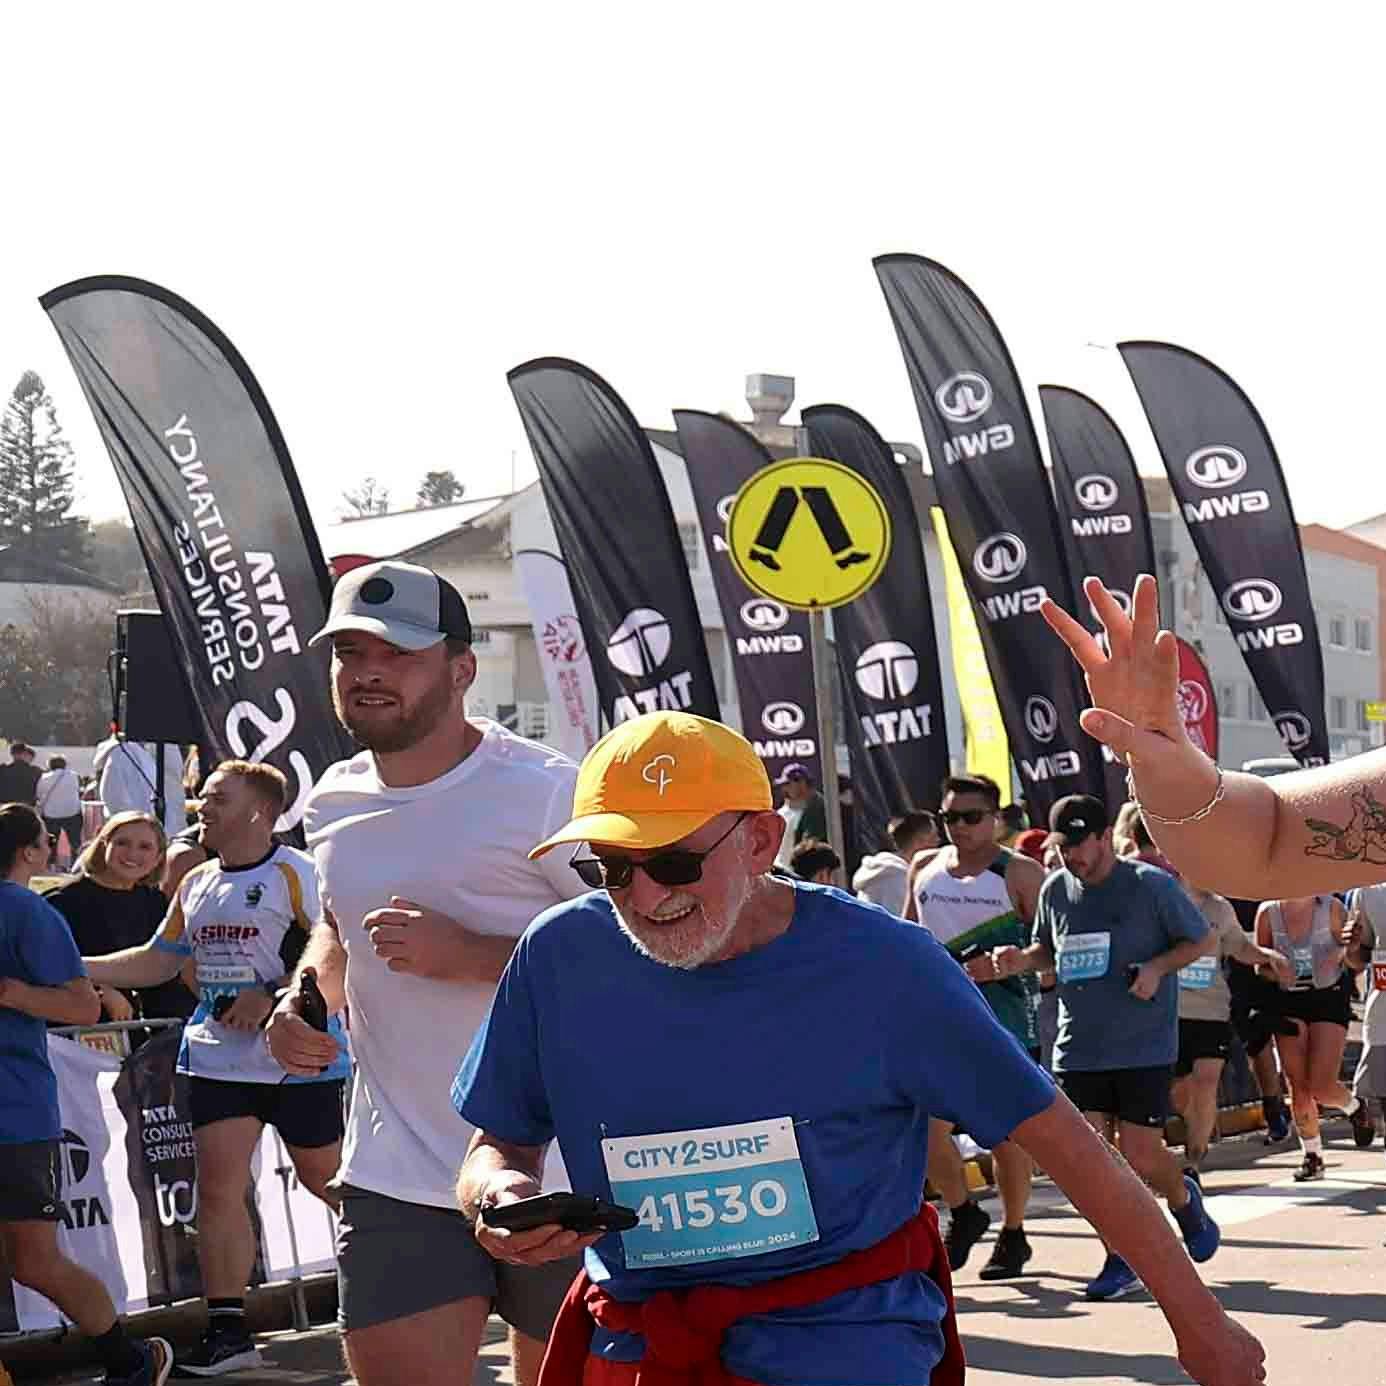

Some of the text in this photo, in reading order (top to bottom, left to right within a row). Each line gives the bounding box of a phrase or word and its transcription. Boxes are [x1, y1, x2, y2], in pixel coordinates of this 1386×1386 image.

[142, 1104, 177, 1124] TATA
[624, 1134, 770, 1170] CITY2SURF
[57, 1197, 111, 1229] ATA
[636, 1179, 788, 1233] 41530
